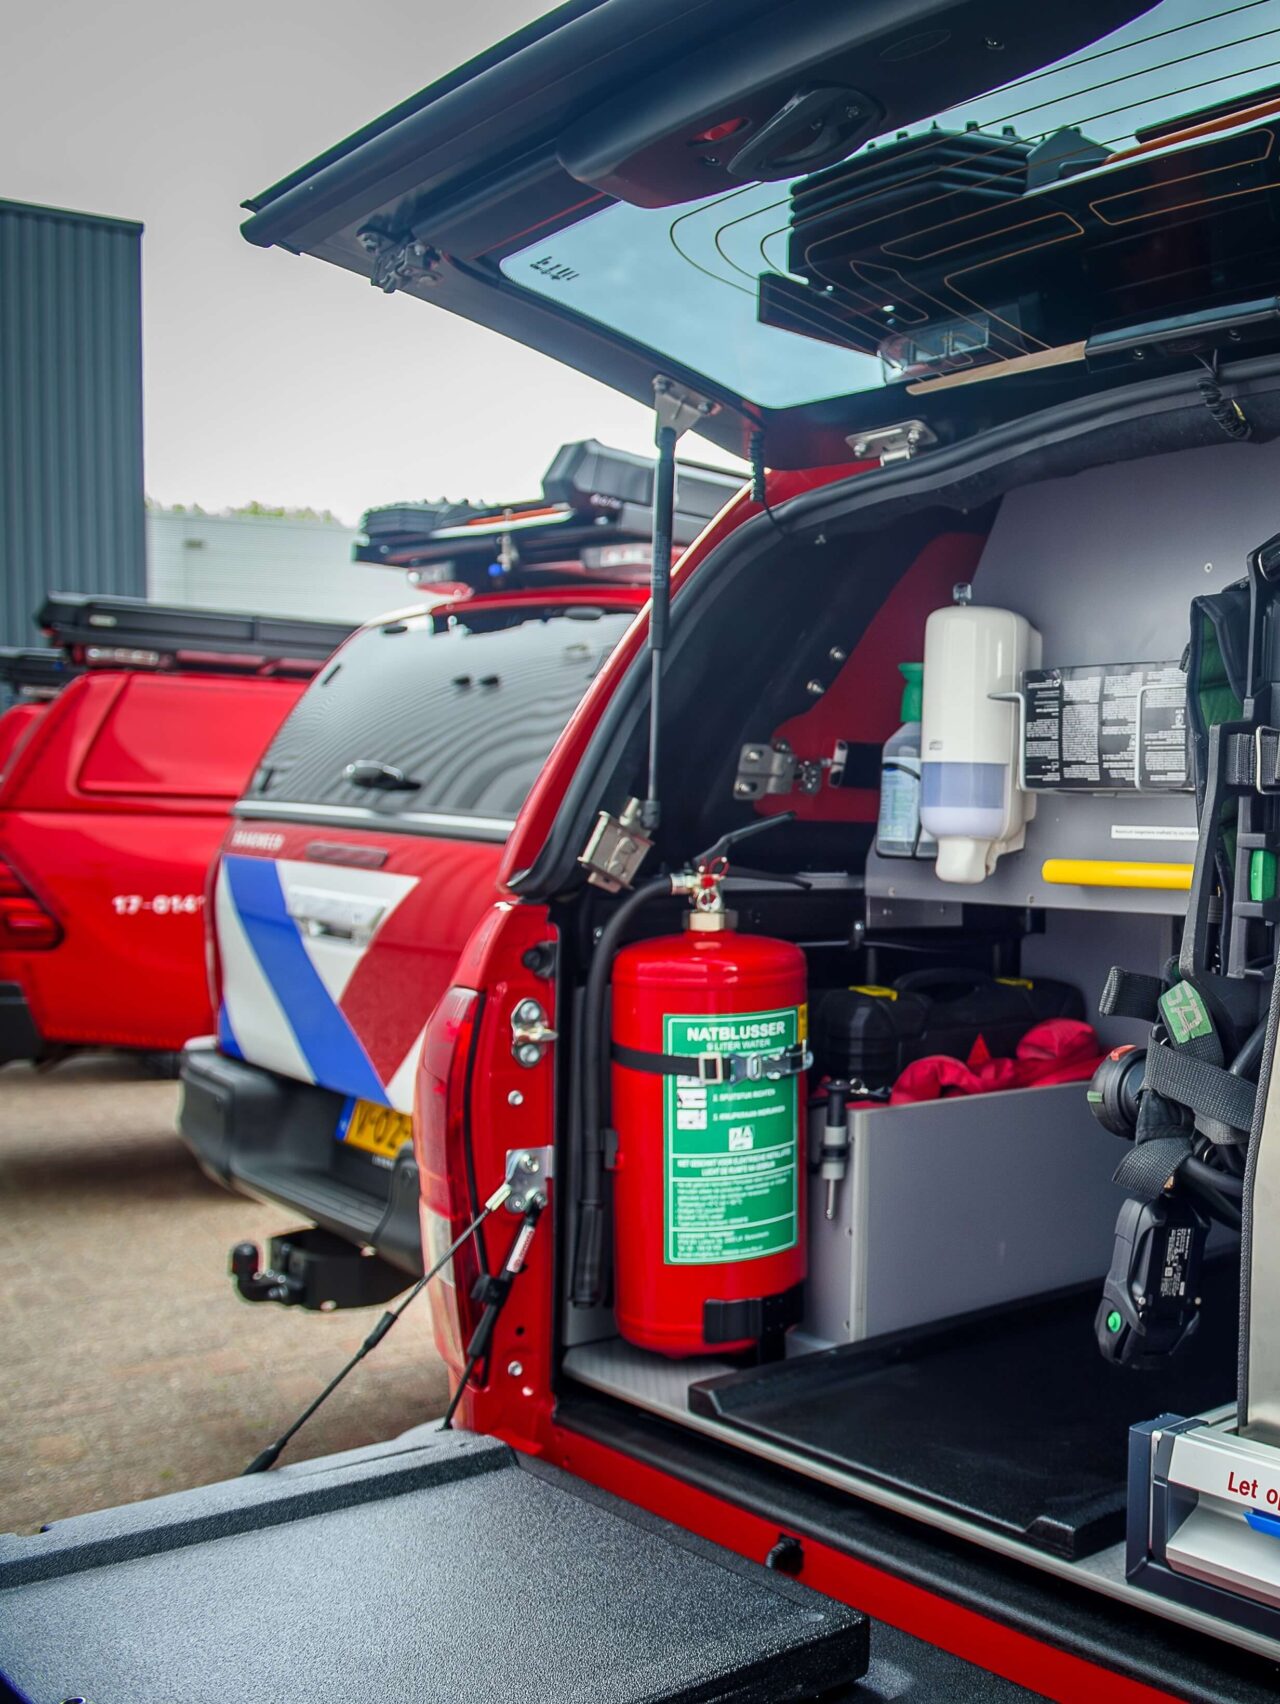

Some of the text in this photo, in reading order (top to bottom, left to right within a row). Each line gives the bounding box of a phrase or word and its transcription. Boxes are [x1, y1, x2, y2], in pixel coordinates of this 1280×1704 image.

[687, 1021, 786, 1041] NATBLUSSER
[741, 1038, 771, 1049] WATER
[1227, 1471, 1259, 1499] Let
